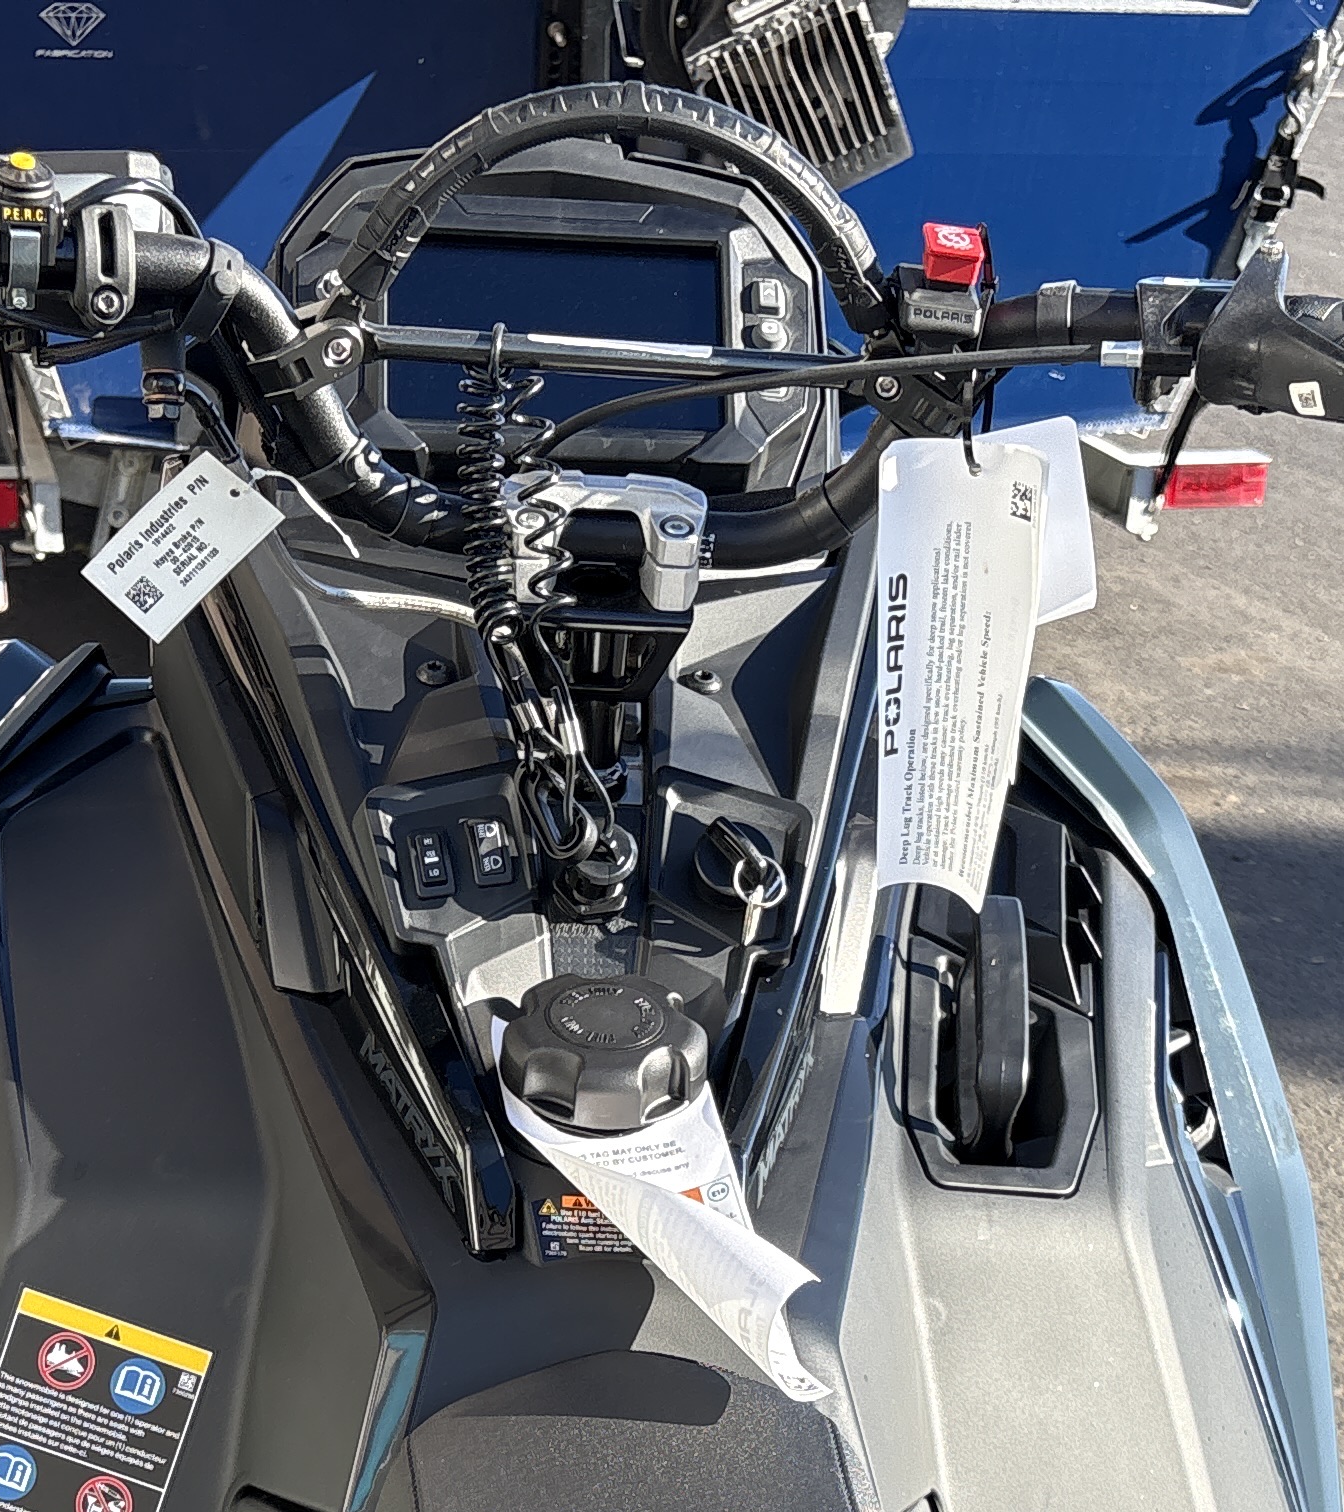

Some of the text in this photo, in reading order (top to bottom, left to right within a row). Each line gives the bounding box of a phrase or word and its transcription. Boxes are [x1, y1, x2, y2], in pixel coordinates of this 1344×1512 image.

[3, 207, 47, 222] P.E.R.C.
[913, 307, 973, 324] POLARIS
[107, 475, 209, 575] Polaris Industries P/N
[172, 531, 192, 550] Brake
[189, 517, 205, 532] P/N
[173, 542, 210, 576] SERIAL NO.
[884, 573, 908, 757] POLARIS
[899, 729, 916, 864] Deep Lug Track Operation
[612, 1147, 632, 1157] MAY
[635, 1143, 660, 1153] ONLY
